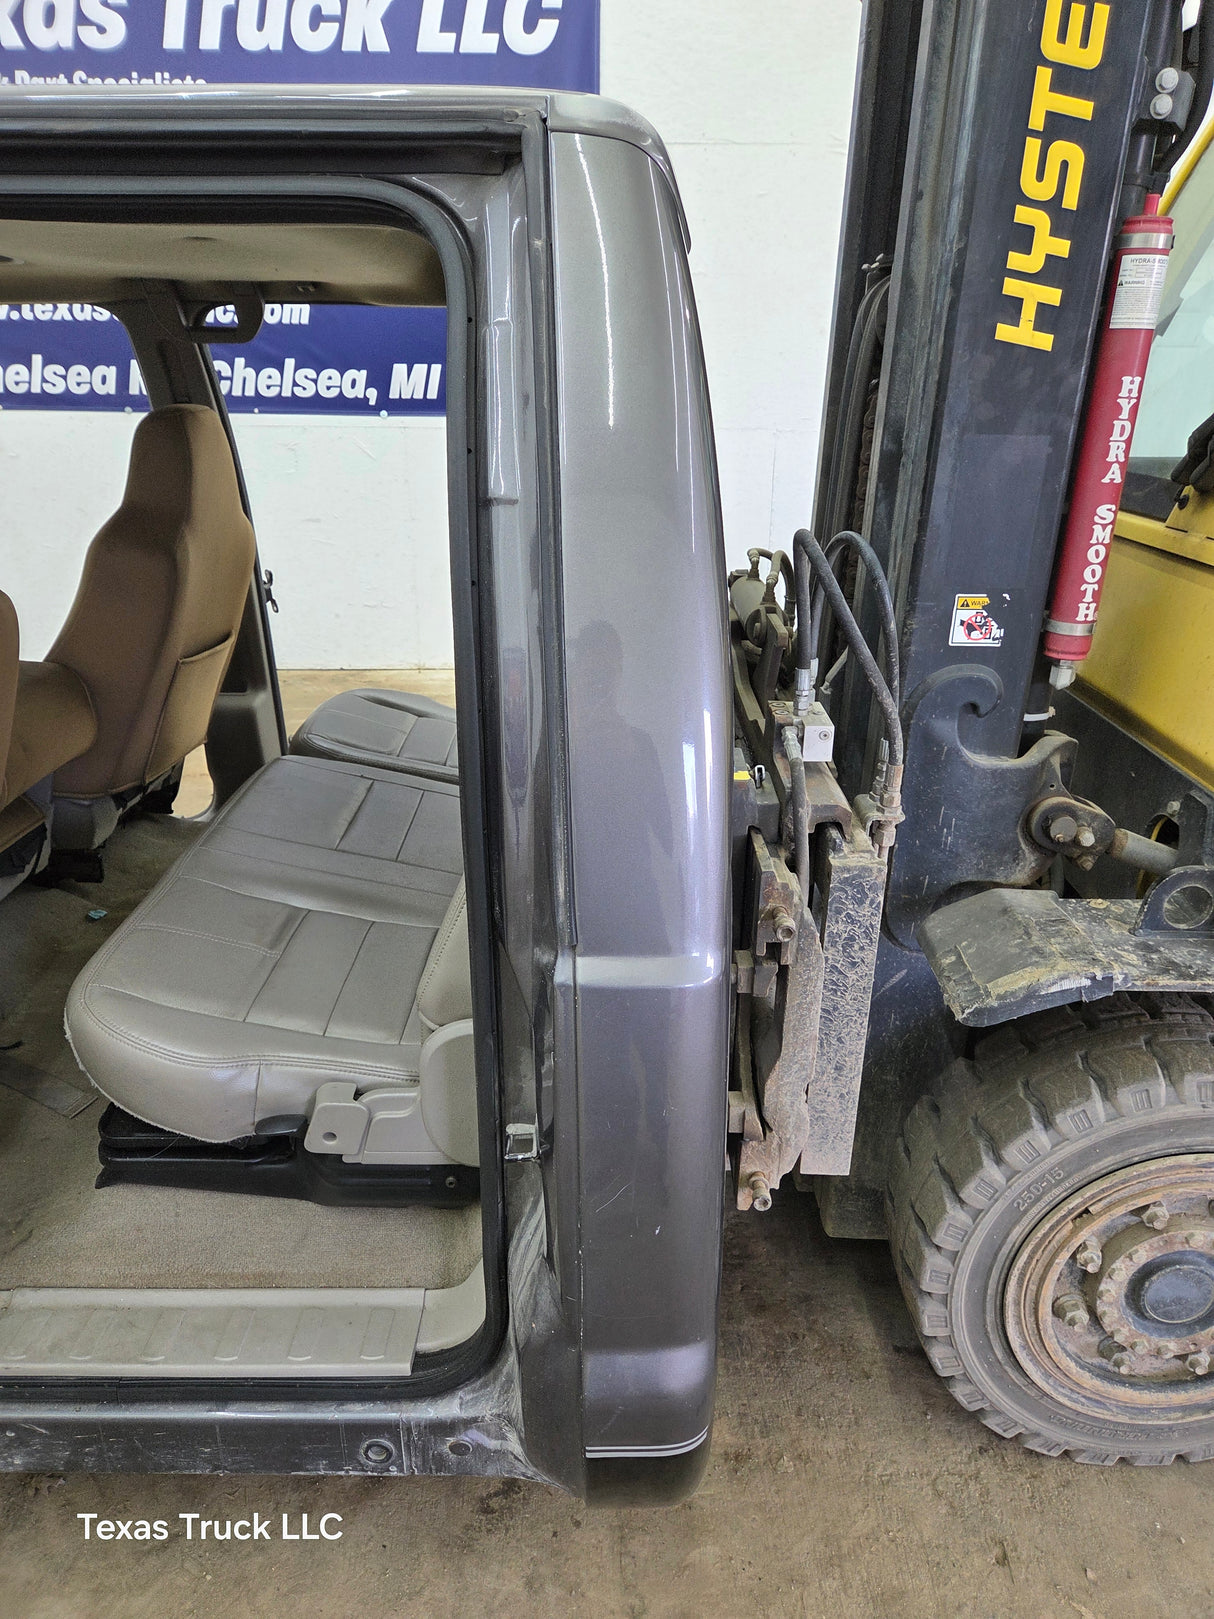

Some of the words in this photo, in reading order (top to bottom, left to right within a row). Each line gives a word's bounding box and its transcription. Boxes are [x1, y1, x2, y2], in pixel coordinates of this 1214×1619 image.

[416, 0, 563, 56] LLC
[995, 0, 1110, 352] HYSTE
[0, 353, 117, 395] elsea
[212, 357, 378, 406] Chelsea,
[388, 363, 442, 400] MI
[1101, 376, 1142, 484] HYDRA
[1076, 504, 1117, 622] SMOOTH
[1013, 1166, 1064, 1212] 250-15
